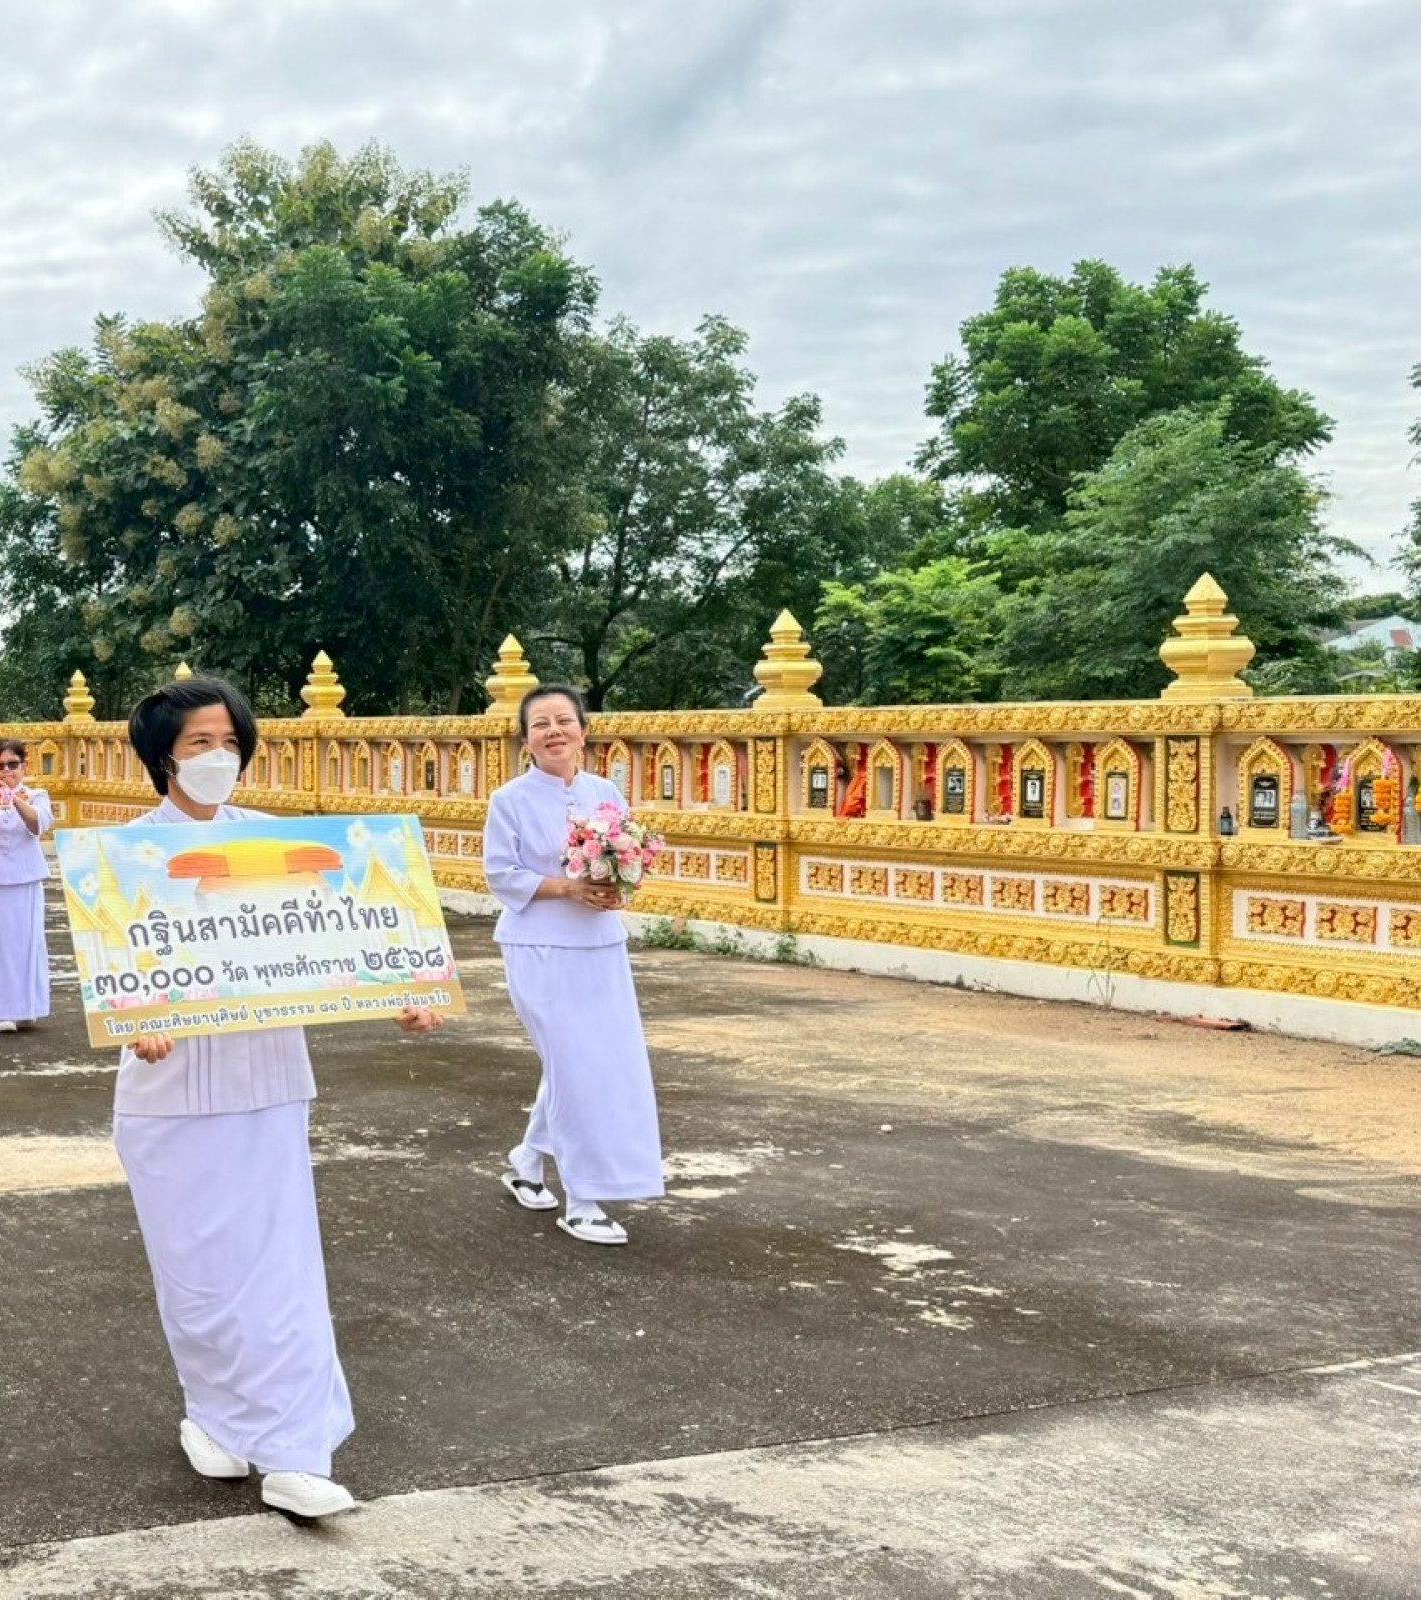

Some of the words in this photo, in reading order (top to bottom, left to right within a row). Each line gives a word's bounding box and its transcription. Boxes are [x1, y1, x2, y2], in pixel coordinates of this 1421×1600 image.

[129, 890, 398, 955] กฐินสามัคคีทั่วไทย
[96, 966, 214, 996] ๓๐,๐๐๐
[222, 960, 249, 983] วัด
[253, 955, 356, 987] พุทธศักราช
[361, 946, 445, 971] ๒๕๖๘
[106, 1019, 134, 1035] โดย
